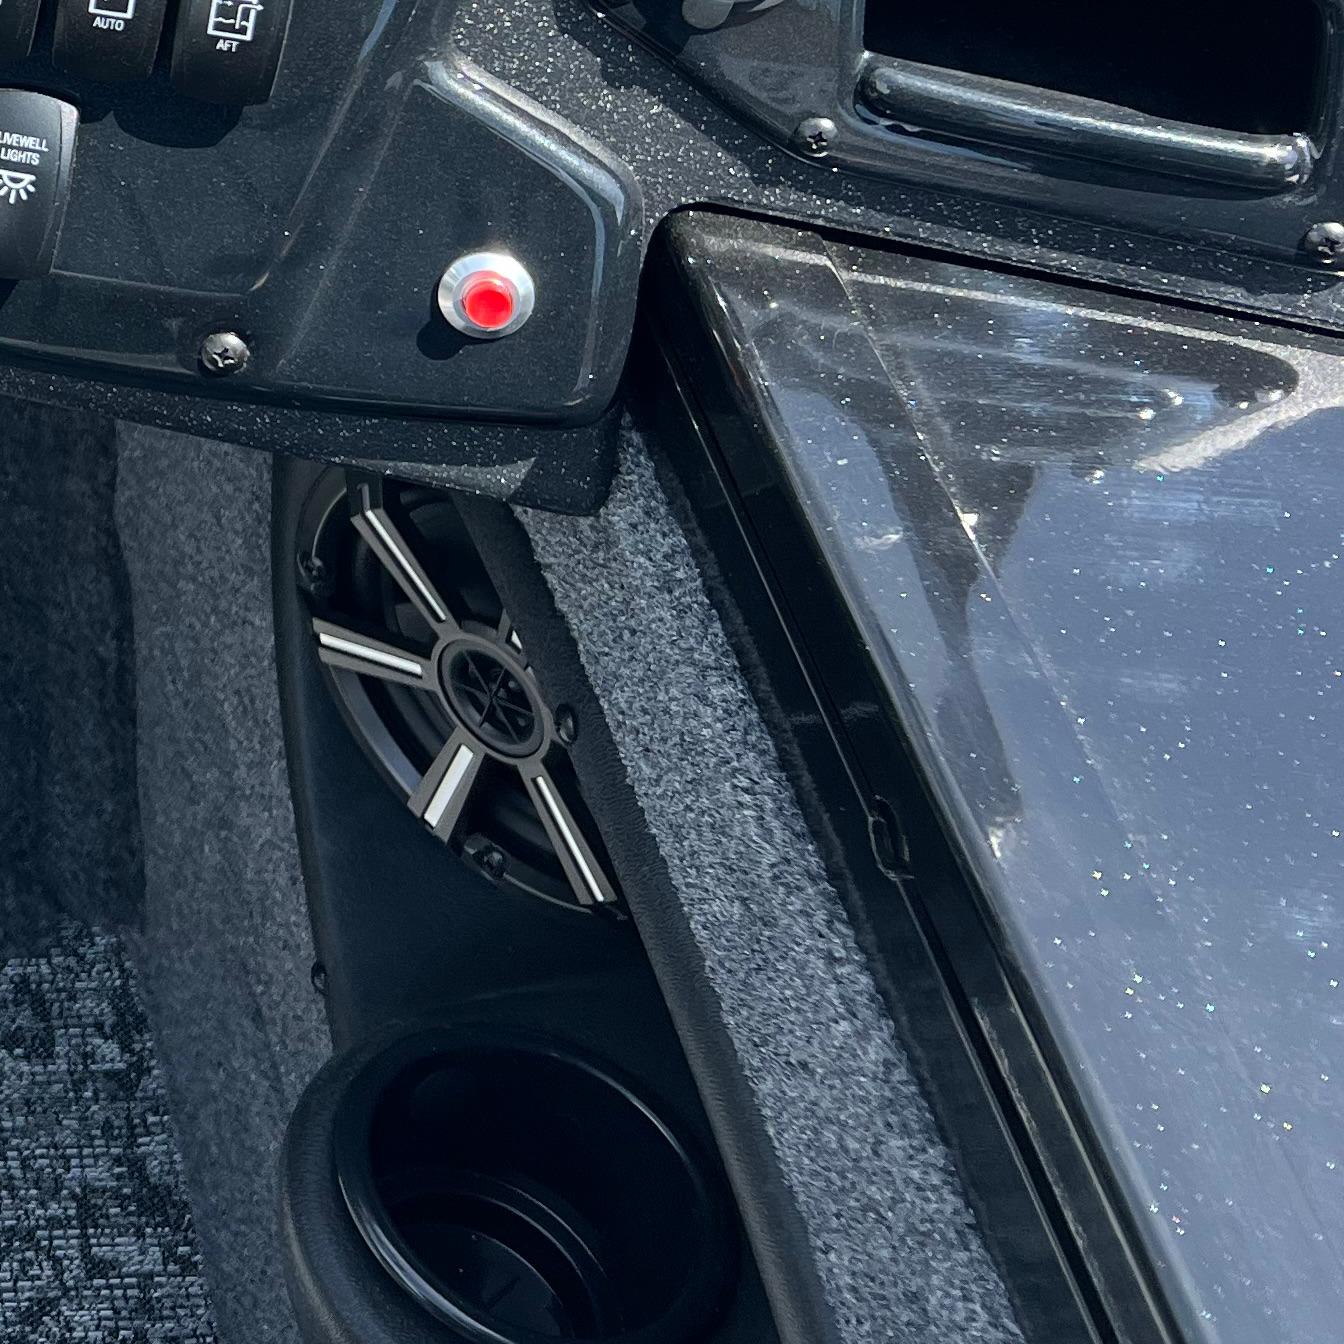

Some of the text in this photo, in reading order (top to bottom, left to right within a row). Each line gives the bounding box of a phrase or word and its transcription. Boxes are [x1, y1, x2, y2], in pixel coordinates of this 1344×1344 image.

[93, 17, 125, 31] AUTO
[216, 39, 240, 52] AFT
[0, 147, 40, 165] LIGHTS
